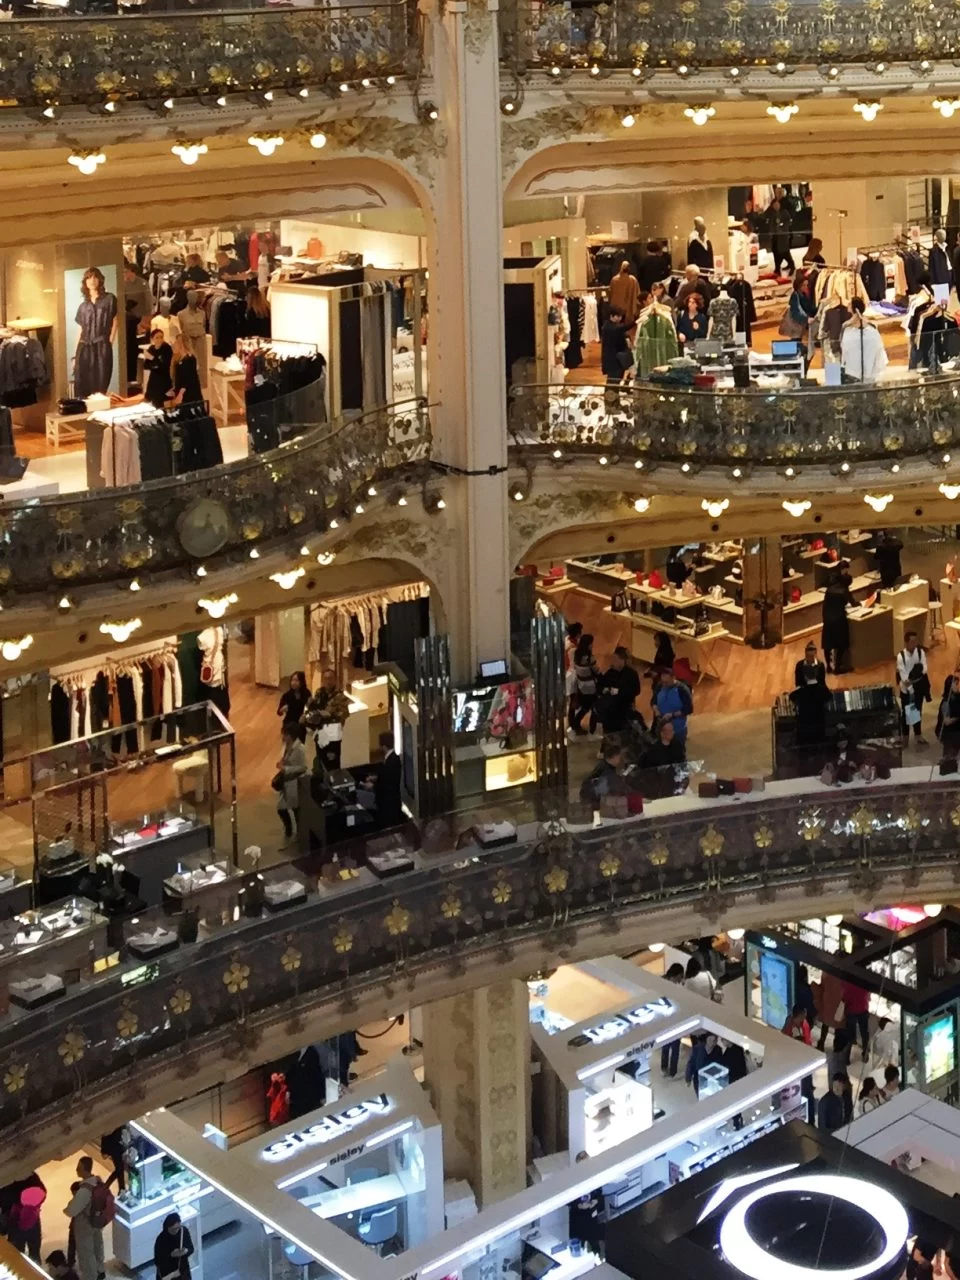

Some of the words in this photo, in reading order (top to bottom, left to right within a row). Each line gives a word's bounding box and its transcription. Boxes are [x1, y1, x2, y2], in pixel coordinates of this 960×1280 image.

[626, 1039, 656, 1057] sisley
[262, 1092, 391, 1161] sisley
[329, 1144, 365, 1166] sisley
